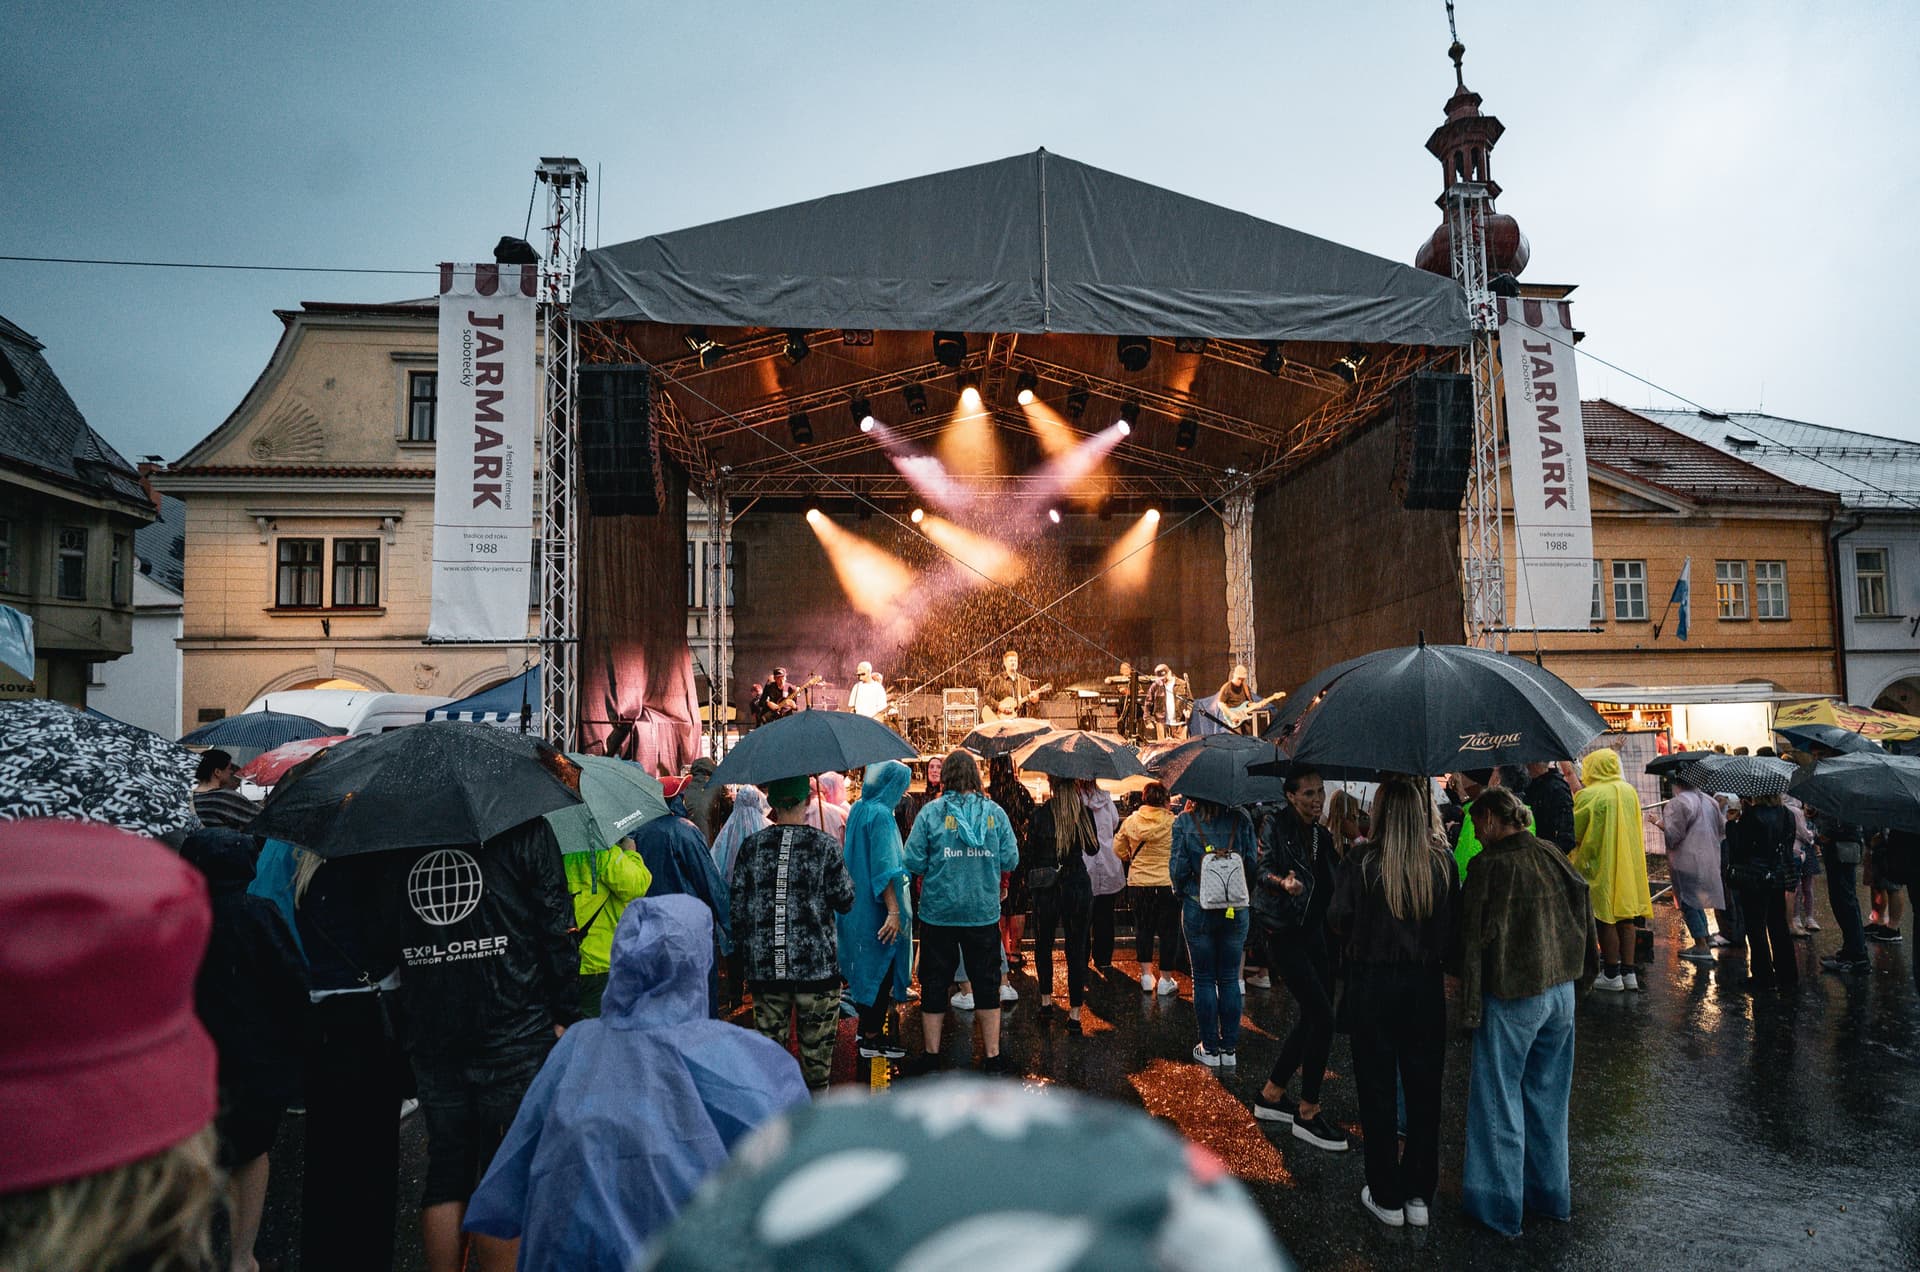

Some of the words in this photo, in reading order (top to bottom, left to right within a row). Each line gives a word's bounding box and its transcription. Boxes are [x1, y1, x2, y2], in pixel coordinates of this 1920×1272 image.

[460, 329, 474, 387] sobotecký
[1520, 353, 1534, 404] sobotecký
[468, 310, 504, 509] JARMARK
[1522, 339, 1568, 511] JARMARK
[470, 543, 498, 554] 1988
[1545, 541, 1568, 551] 1988
[943, 847, 963, 858] Run
[967, 847, 994, 858] Blue.
[402, 935, 509, 959] EXPLORER
[446, 948, 506, 962] GARMENTS
